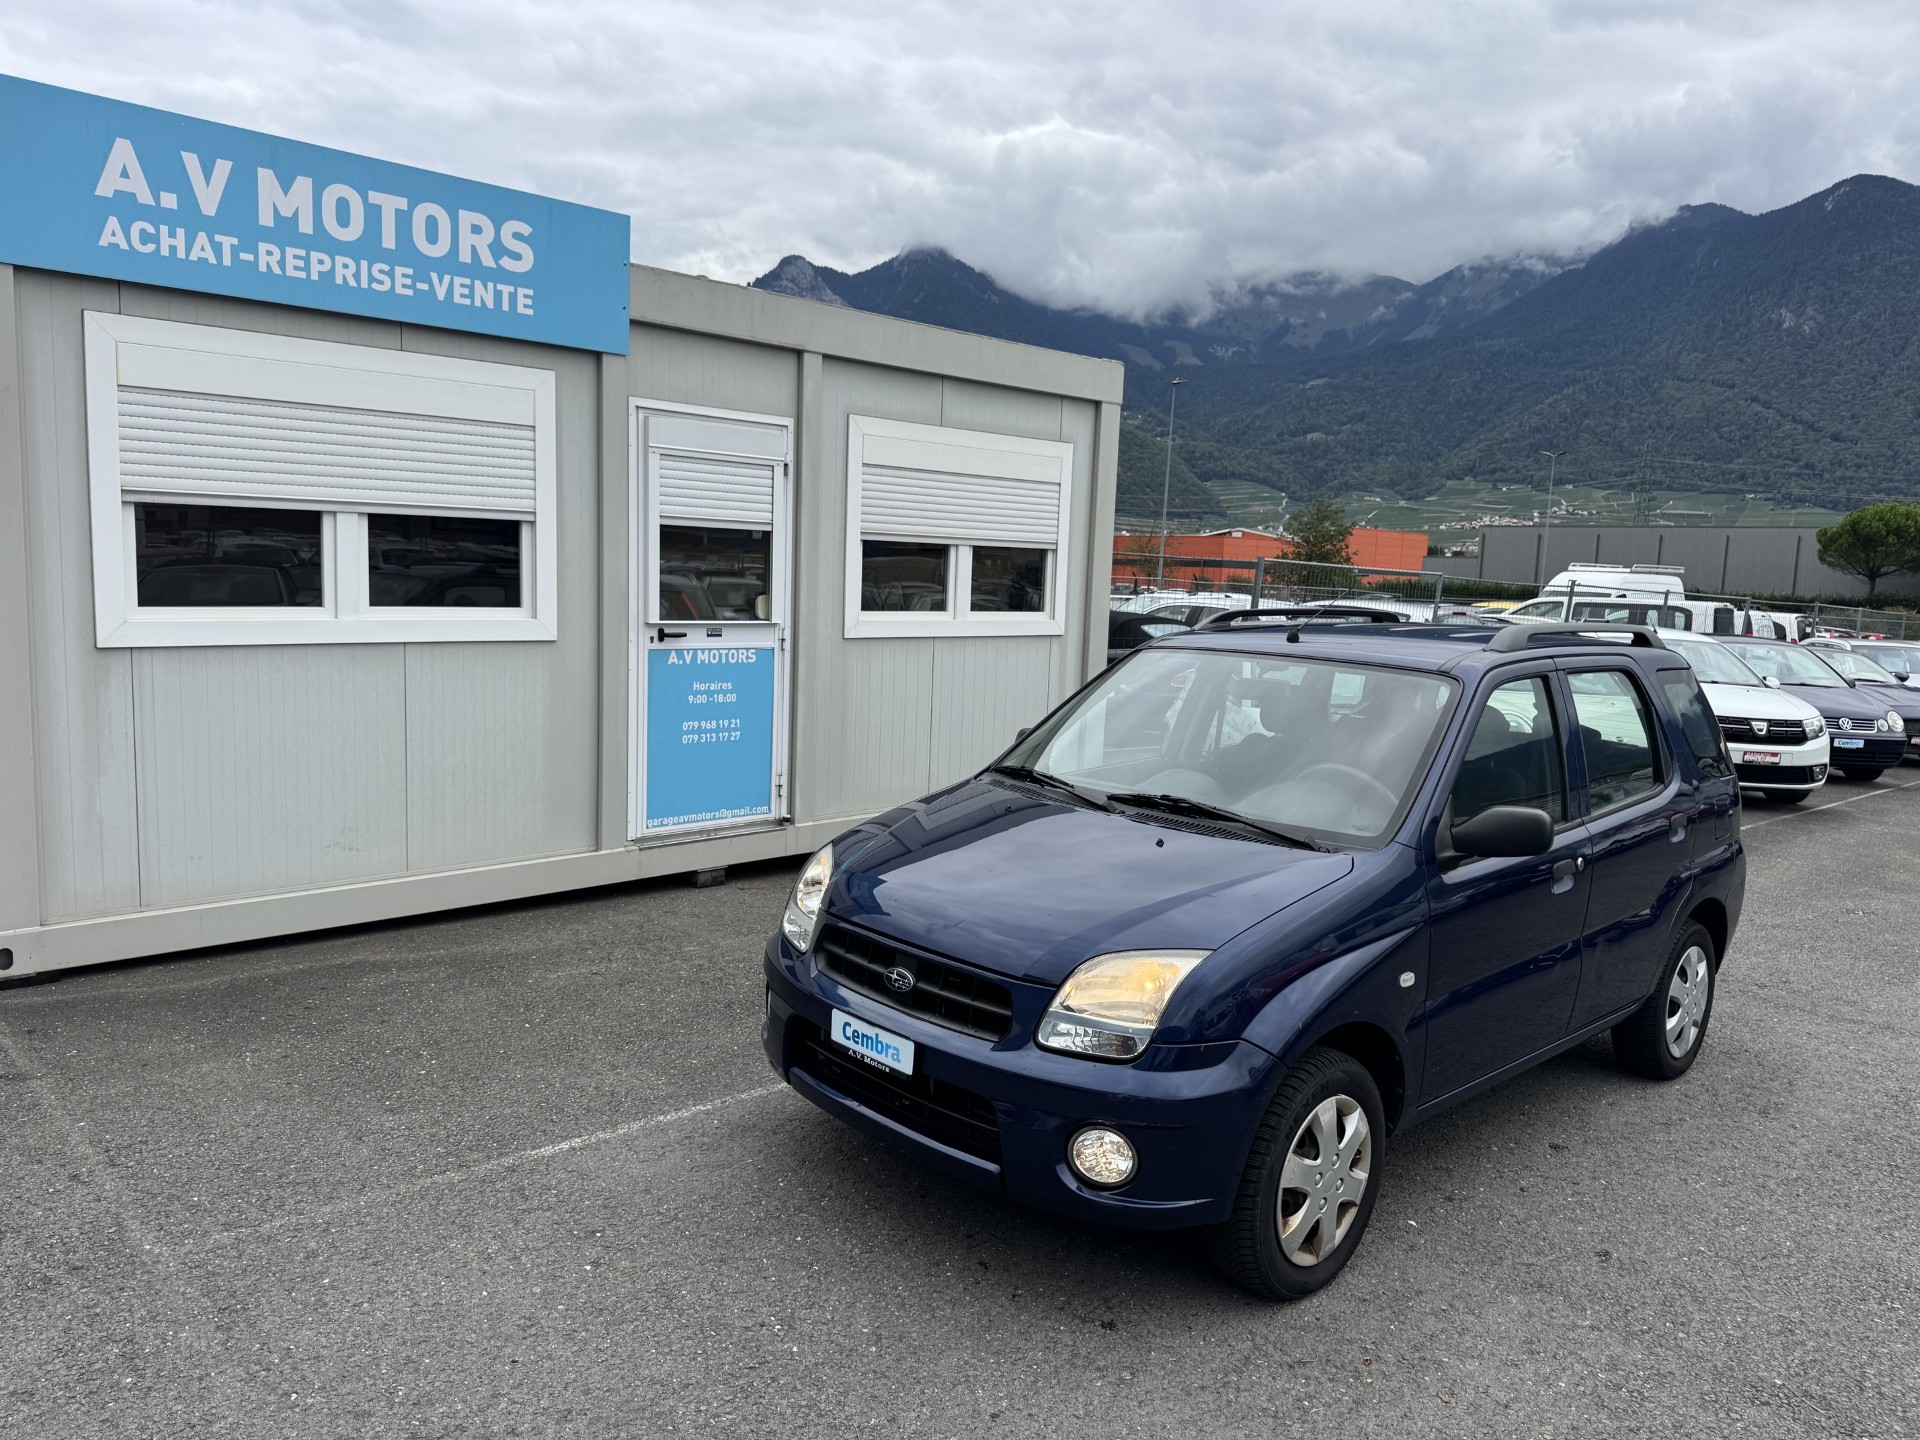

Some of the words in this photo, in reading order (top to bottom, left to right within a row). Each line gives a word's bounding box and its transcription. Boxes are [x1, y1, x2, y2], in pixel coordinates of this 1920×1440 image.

[95, 137, 233, 217] A.V
[257, 167, 535, 273] MOTORS
[98, 215, 535, 316] ACHAT-REPRISE-VENTE
[667, 649, 693, 665] A.V
[697, 648, 757, 664] MOTORS
[693, 680, 733, 691] Horaires
[688, 694, 707, 704] 9:00
[682, 721, 699, 731] 079
[700, 720, 717, 730] 968
[718, 719, 729, 729] 19
[730, 718, 740, 728] 21
[682, 734, 699, 744] 079
[700, 733, 716, 743] 313
[718, 732, 729, 742] 17
[730, 731, 741, 741] 27
[647, 805, 769, 827] garageavmotors@gmail.com
[842, 1021, 901, 1063] Cembra
[848, 1049, 863, 1061] A.V.
[863, 1055, 890, 1073] Motors
